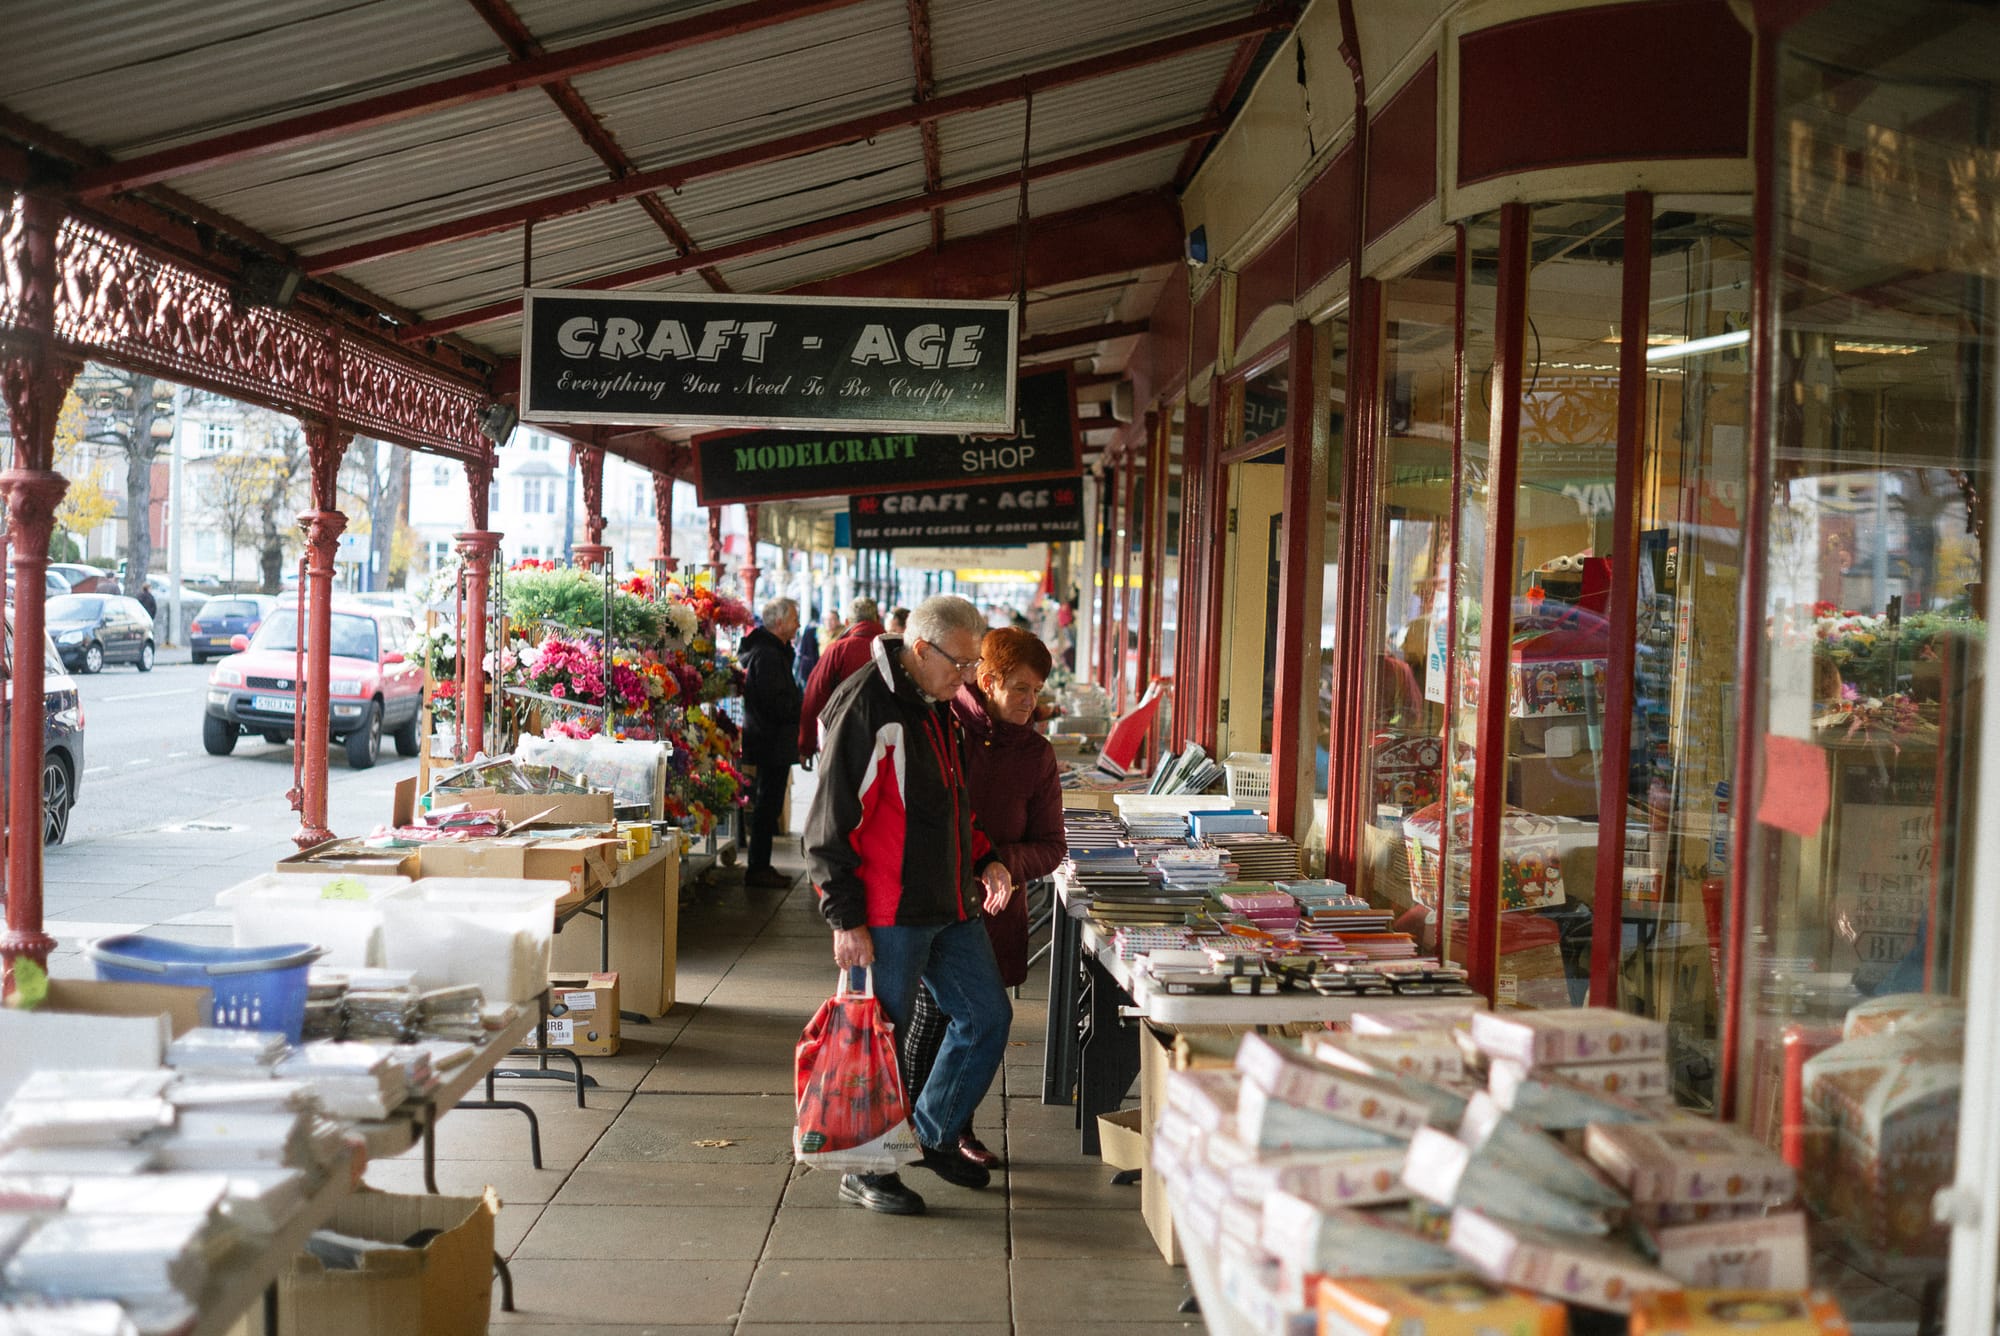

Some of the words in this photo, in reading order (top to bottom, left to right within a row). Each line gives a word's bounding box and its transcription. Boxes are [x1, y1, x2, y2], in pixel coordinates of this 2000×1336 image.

[557, 316, 777, 363] CRAFT
[802, 336, 823, 349] -
[850, 323, 985, 369] AGE
[557, 370, 666, 400] Everything
[682, 372, 720, 395] You
[734, 374, 792, 396] Need
[801, 375, 825, 396] To
[840, 377, 871, 397] Be
[888, 377, 954, 406] Crafty
[966, 382, 985, 399] !!
[735, 434, 918, 472] MODELCRAFT
[962, 445, 1036, 472] SHOP
[883, 492, 969, 514] CRAFT
[998, 489, 1050, 509] AGE
[857, 528, 879, 538] THE
[883, 526, 922, 537] CRAFT
[926, 524, 971, 536] CENTRE
[975, 523, 993, 533] OF
[995, 522, 1038, 533] NORTH
